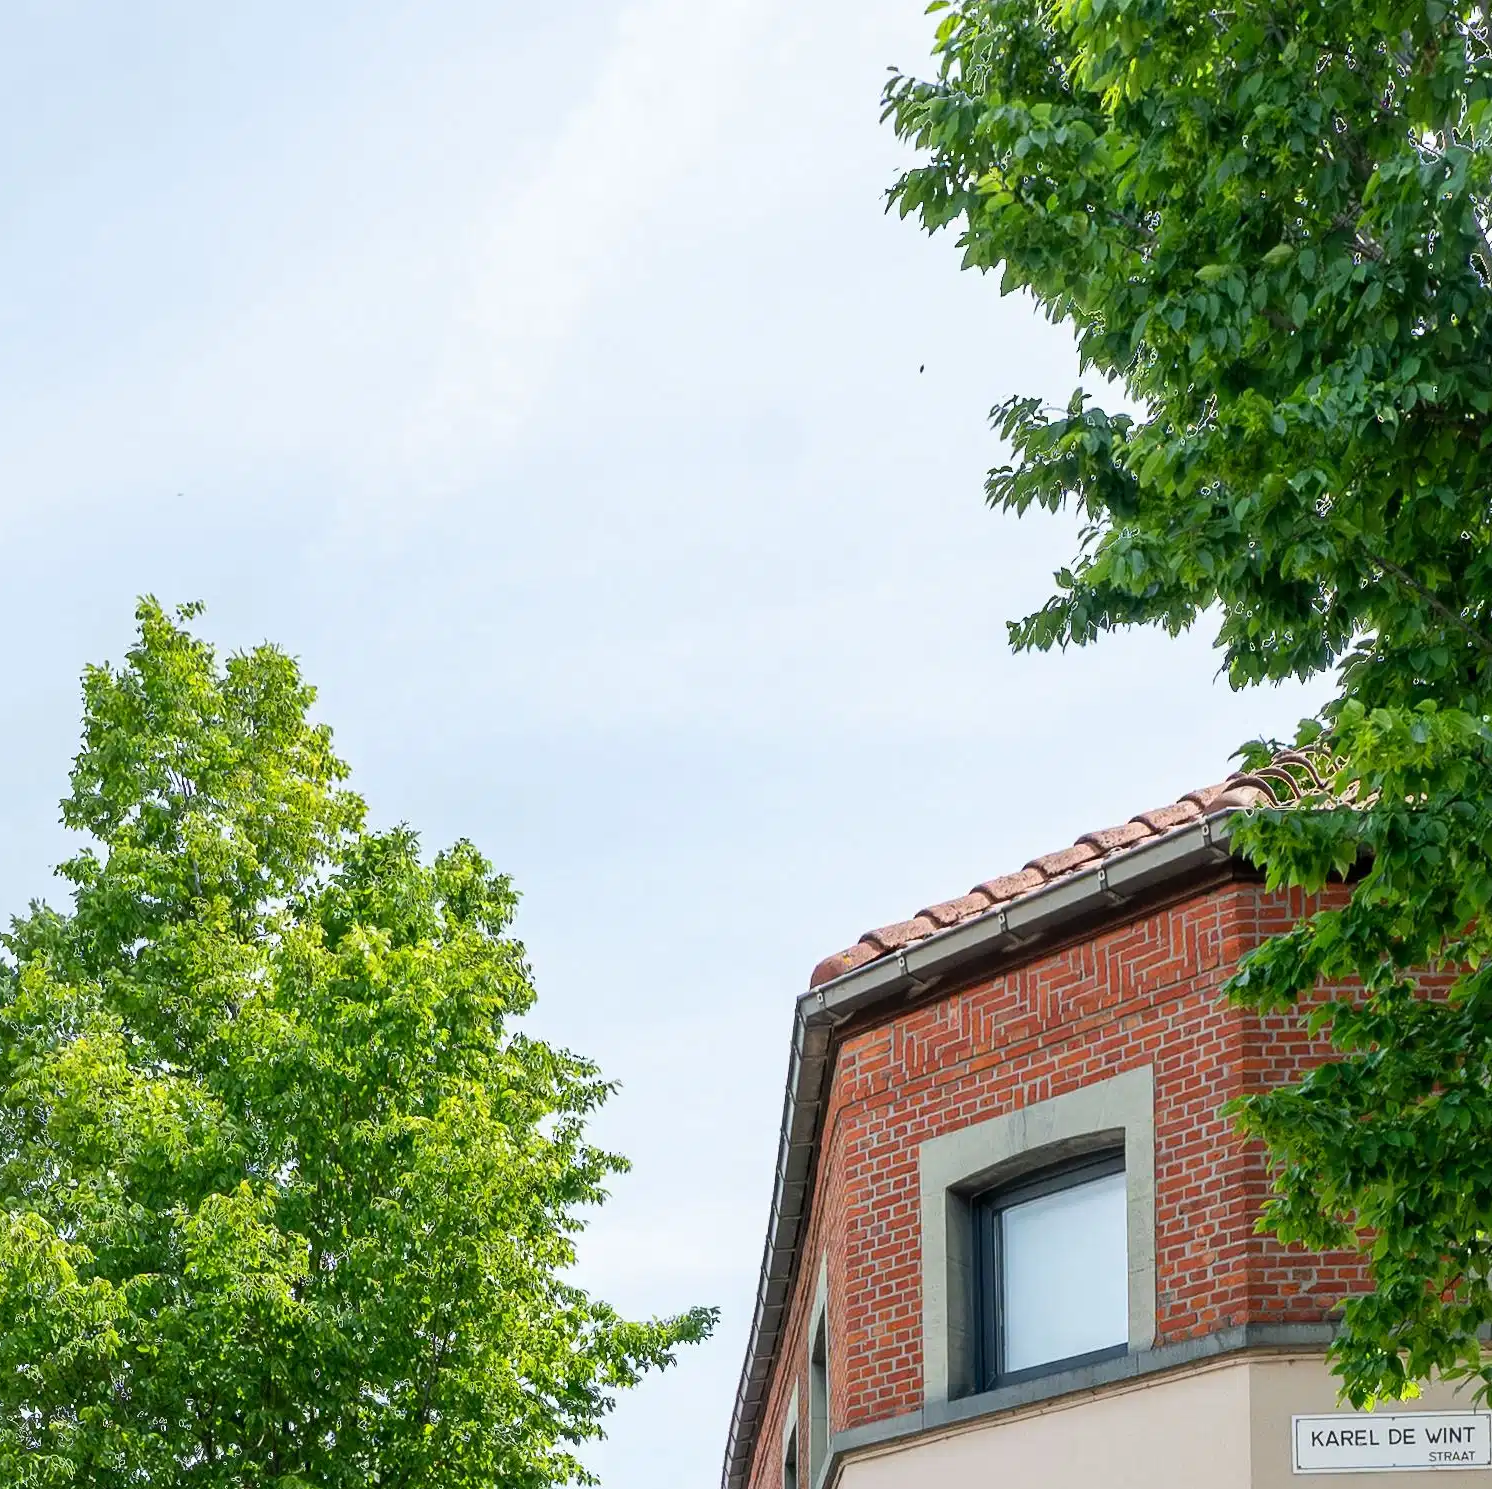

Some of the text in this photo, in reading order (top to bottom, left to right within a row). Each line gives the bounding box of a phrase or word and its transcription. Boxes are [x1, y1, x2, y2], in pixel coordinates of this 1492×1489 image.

[1311, 1427, 1476, 1447] KAREL DE WINT
[1428, 1450, 1476, 1462] STRAAT
